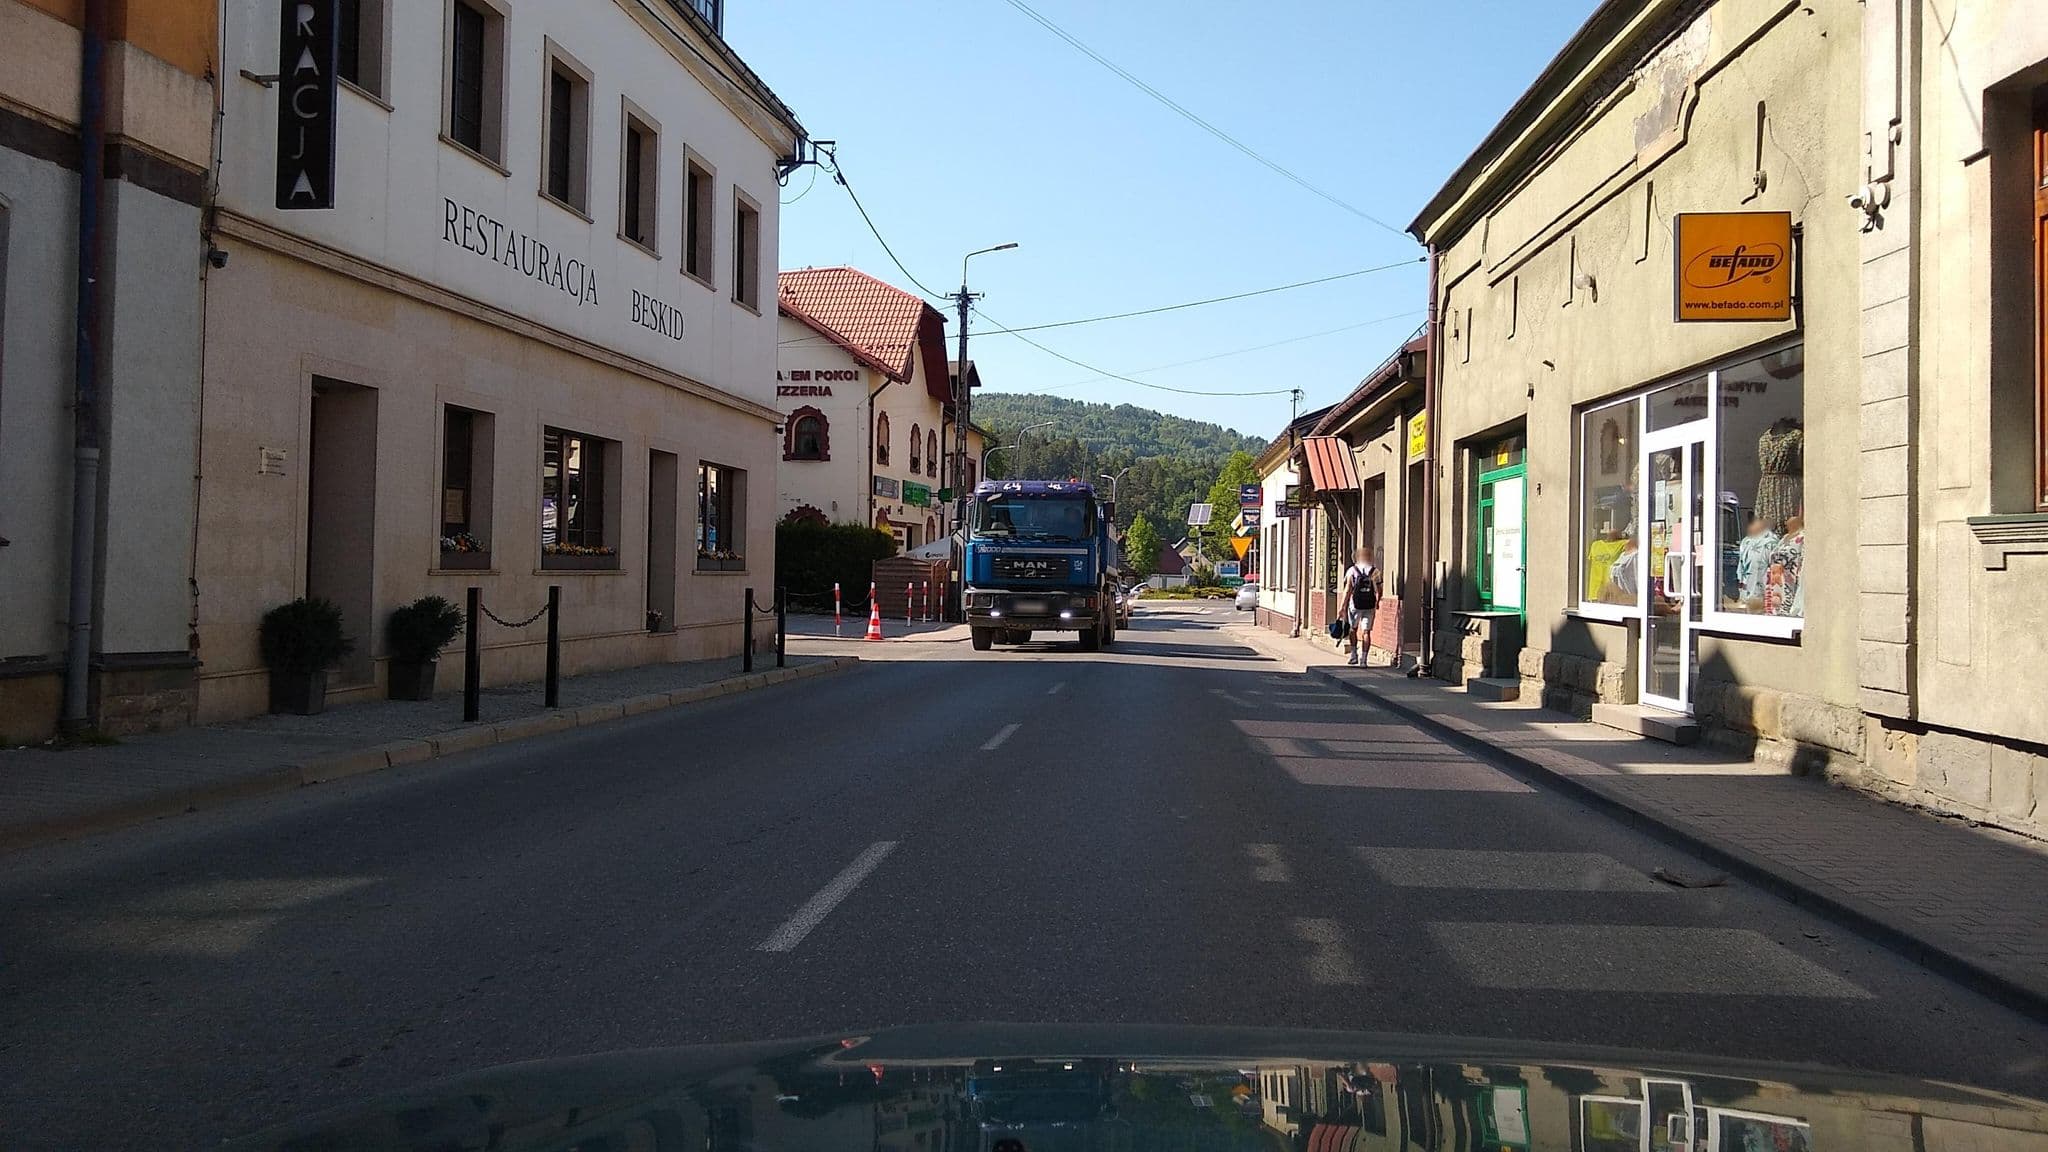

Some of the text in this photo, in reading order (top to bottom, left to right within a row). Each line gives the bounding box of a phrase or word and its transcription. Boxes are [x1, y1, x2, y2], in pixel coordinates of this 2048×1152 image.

[289, 3, 320, 201] RACJA
[443, 198, 684, 341] RESTAURACJA BESKID
[1685, 300, 1784, 309] www.befado.com.pl
[1013, 561, 1047, 569] MAN
